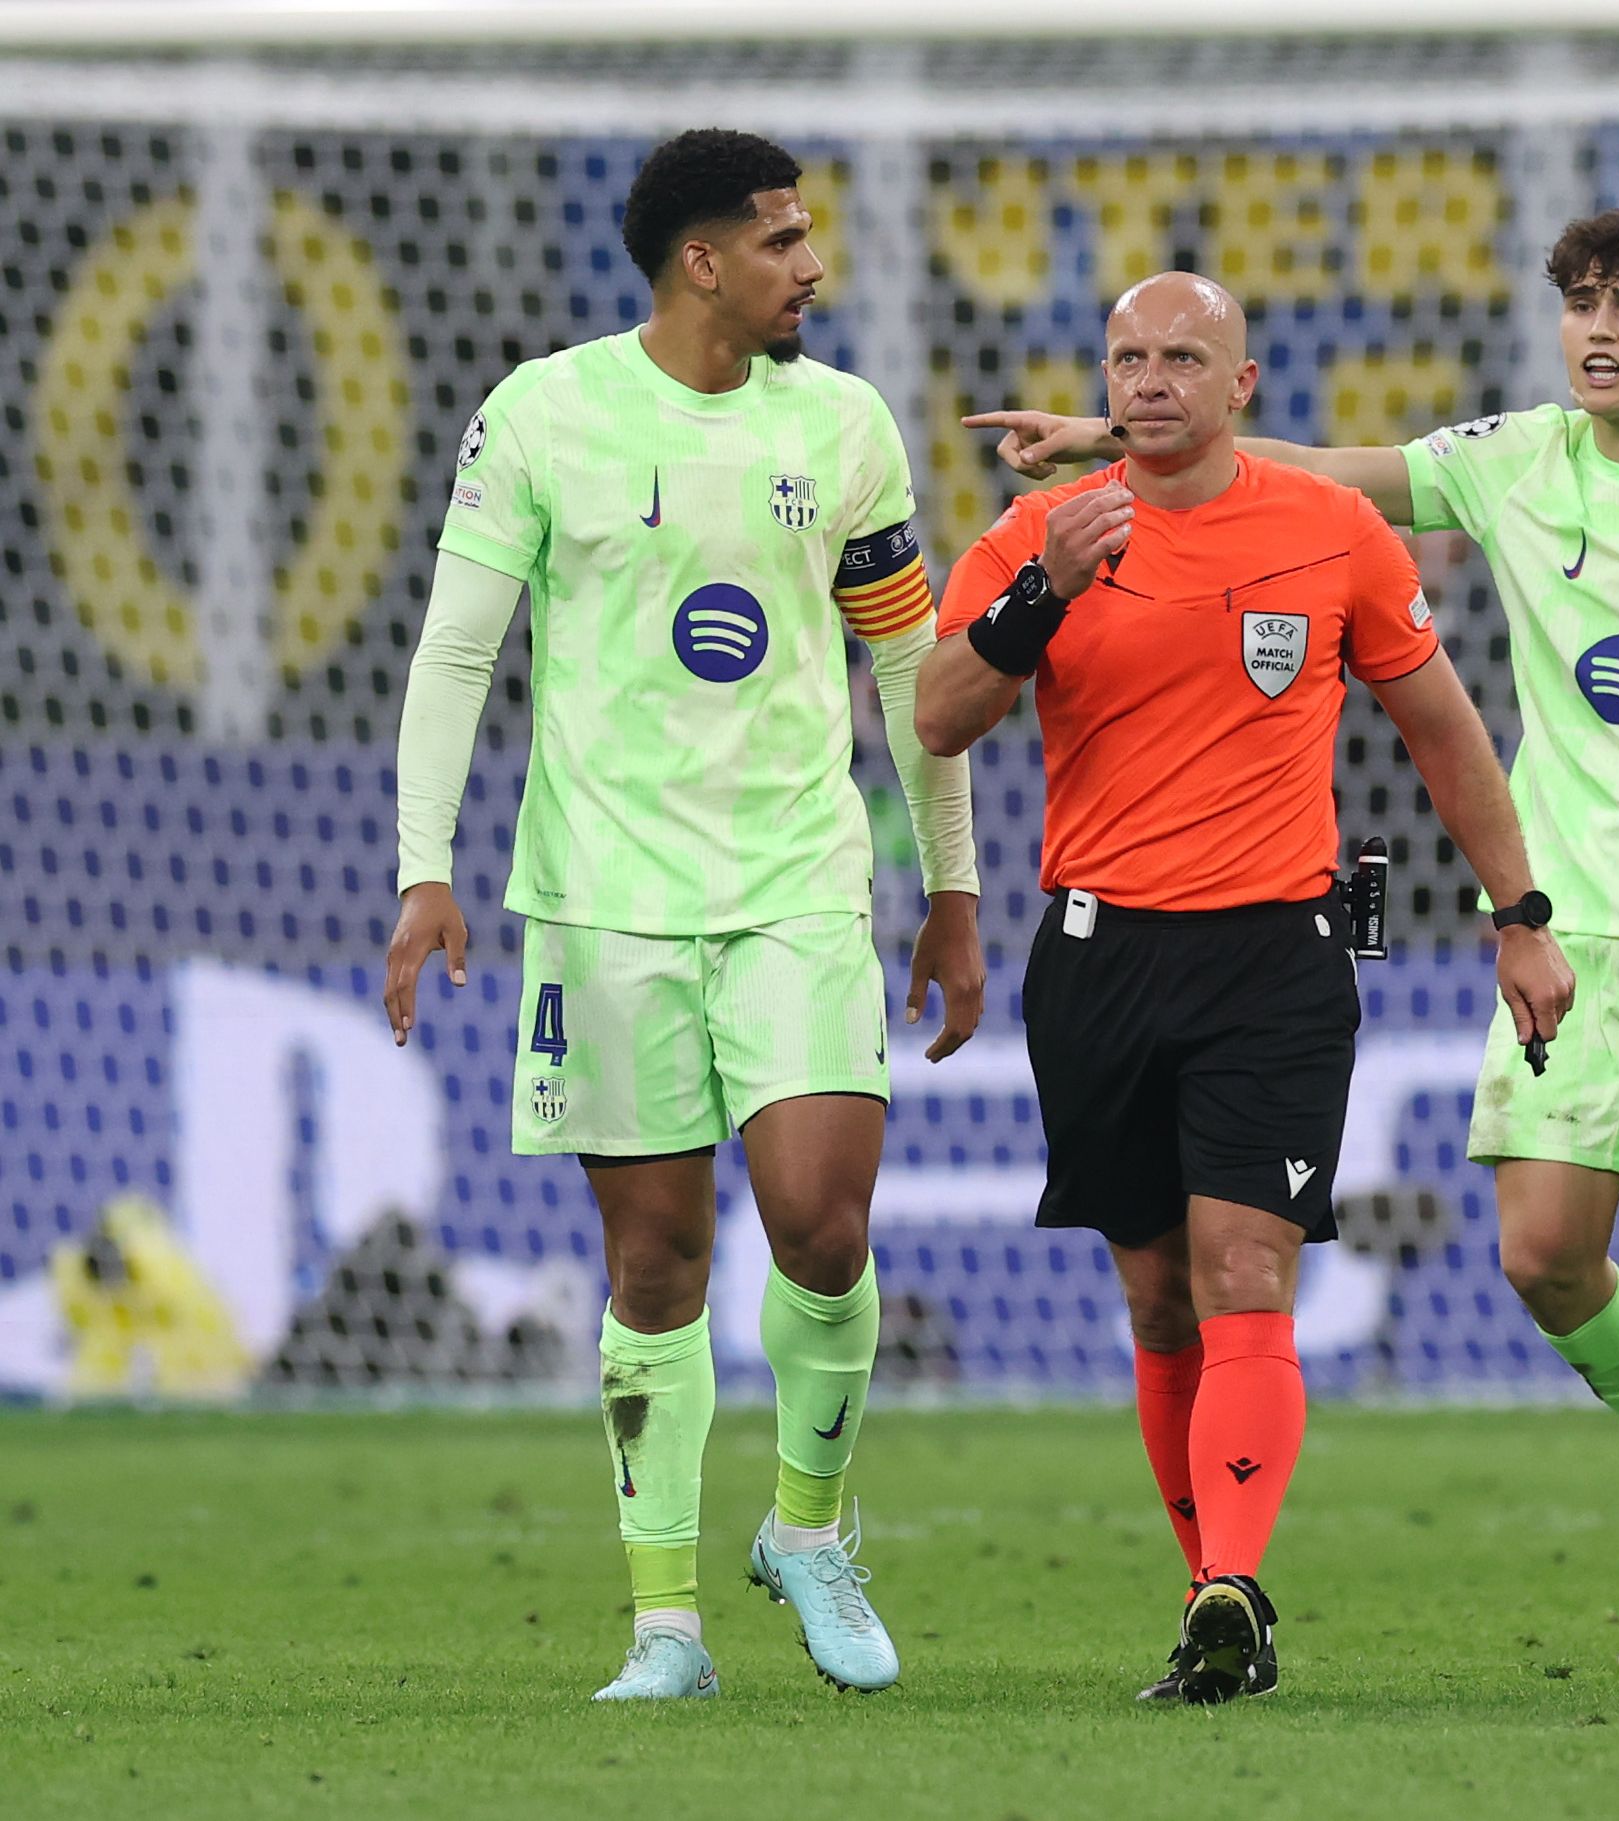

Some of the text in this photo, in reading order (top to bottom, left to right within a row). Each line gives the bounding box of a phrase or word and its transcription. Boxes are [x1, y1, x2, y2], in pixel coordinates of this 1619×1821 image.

[1255, 621, 1295, 640] UEFA
[1256, 647, 1294, 660] MATCH
[1251, 659, 1295, 673] OFFICIAL
[530, 982, 568, 1068] 4
